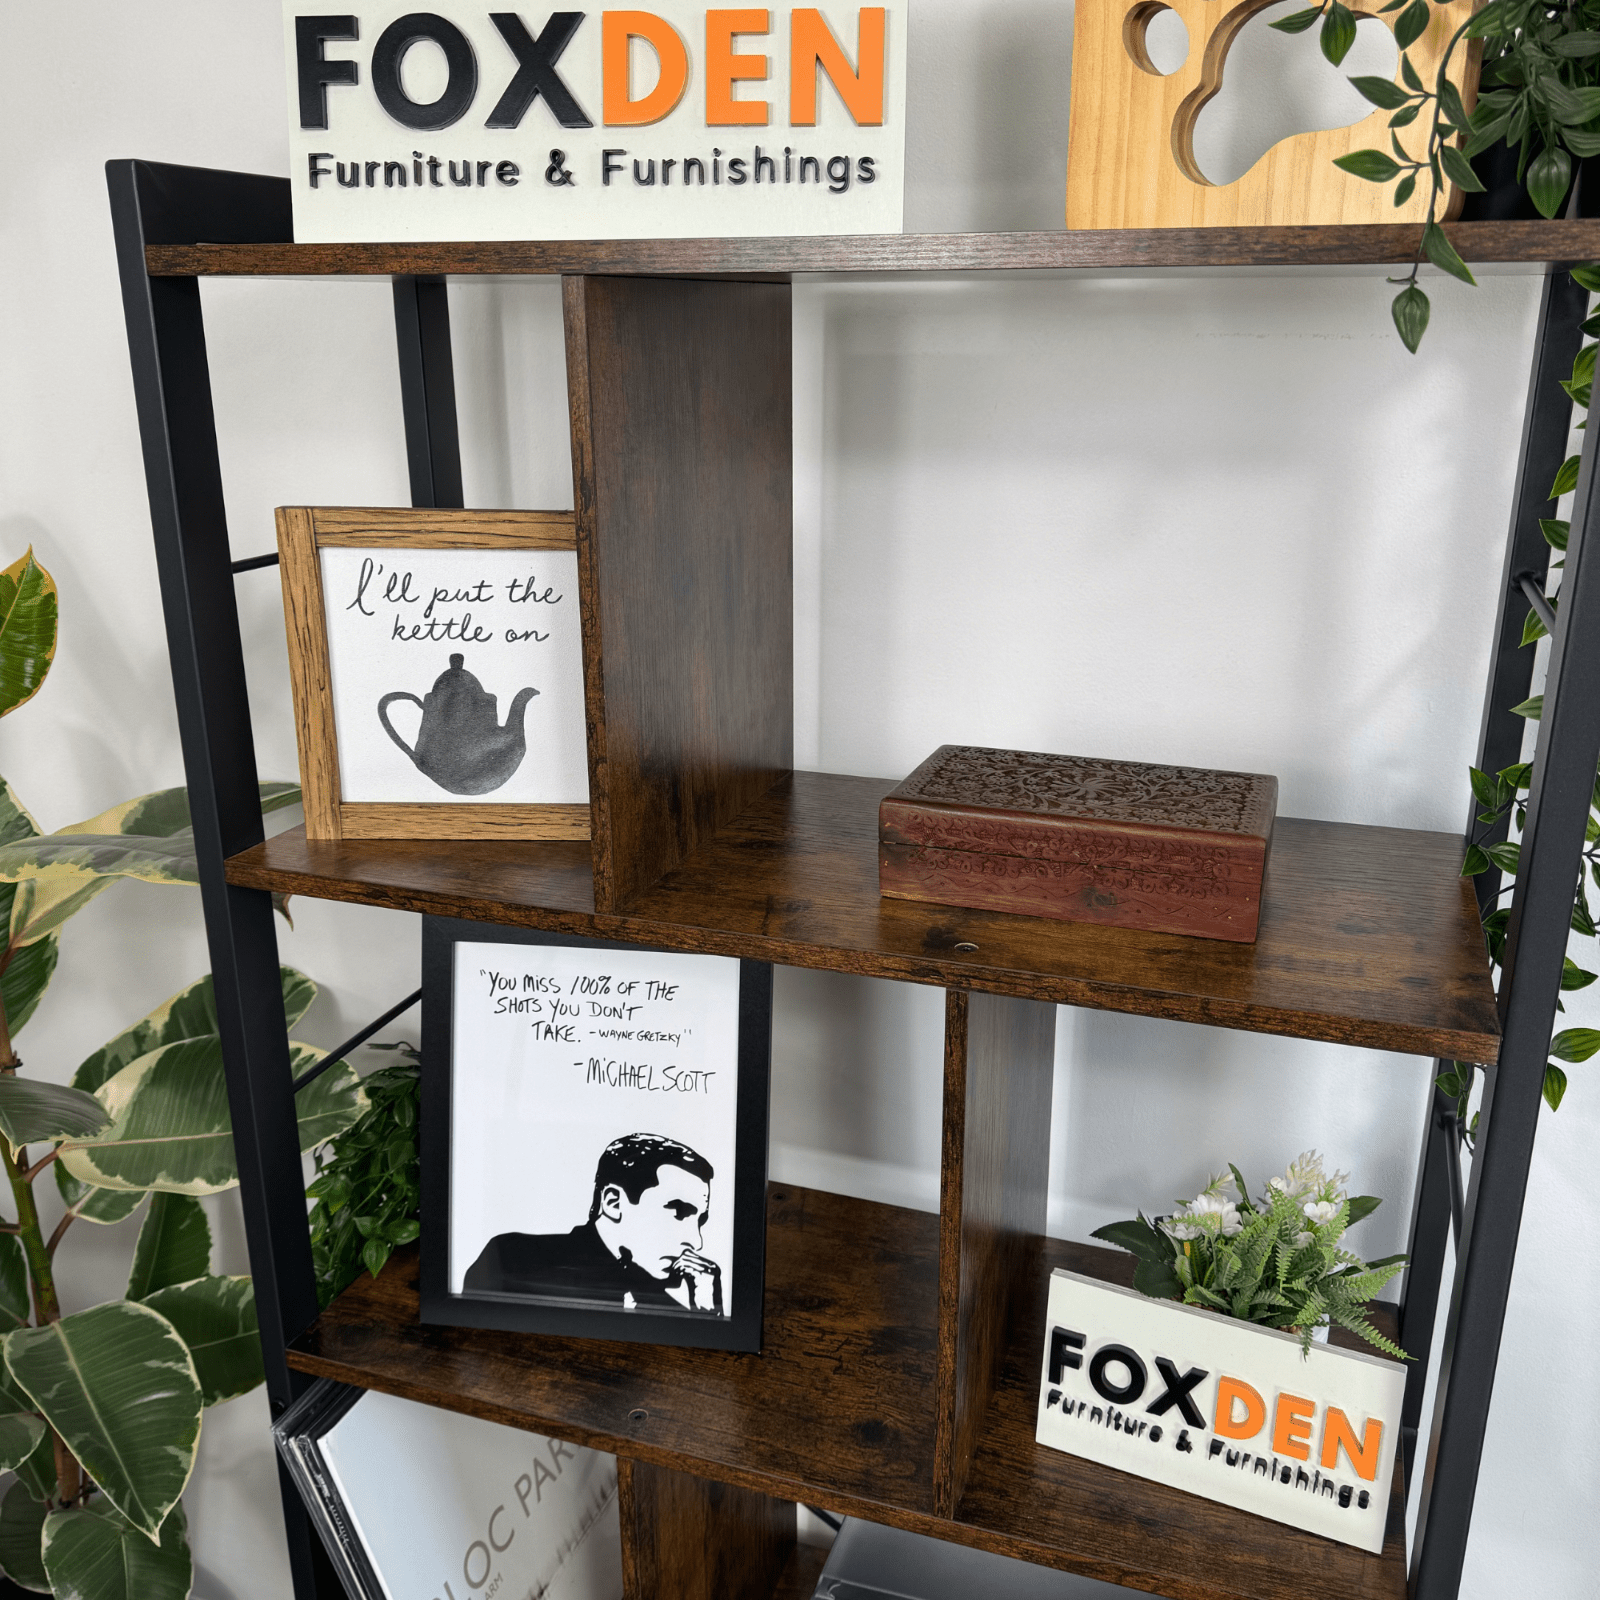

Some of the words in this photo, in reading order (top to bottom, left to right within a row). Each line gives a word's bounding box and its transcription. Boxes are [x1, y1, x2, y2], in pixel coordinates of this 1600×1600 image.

[307, 149, 520, 190] Furniture
[544, 148, 576, 187] &
[602, 145, 877, 194] Furnishings
[346, 557, 420, 616] I'll
[423, 579, 494, 618] put
[505, 575, 563, 604] the
[391, 612, 494, 643] kettle
[505, 629, 551, 643] on
[570, 975, 612, 996] 100%
[617, 981, 640, 996] OF
[644, 980, 680, 1001] THE
[493, 996, 542, 1014] SHOTS
[549, 998, 580, 1024] YOU
[586, 1001, 644, 1021] DON'T
[531, 1020, 581, 1042] TAKE.
[662, 1065, 717, 1094] SCOTT
[1046, 1388, 1164, 1443] Furniture
[1175, 1429, 1194, 1455] &
[1208, 1438, 1371, 1509] Furnishings
[514, 1437, 583, 1518] PAR
